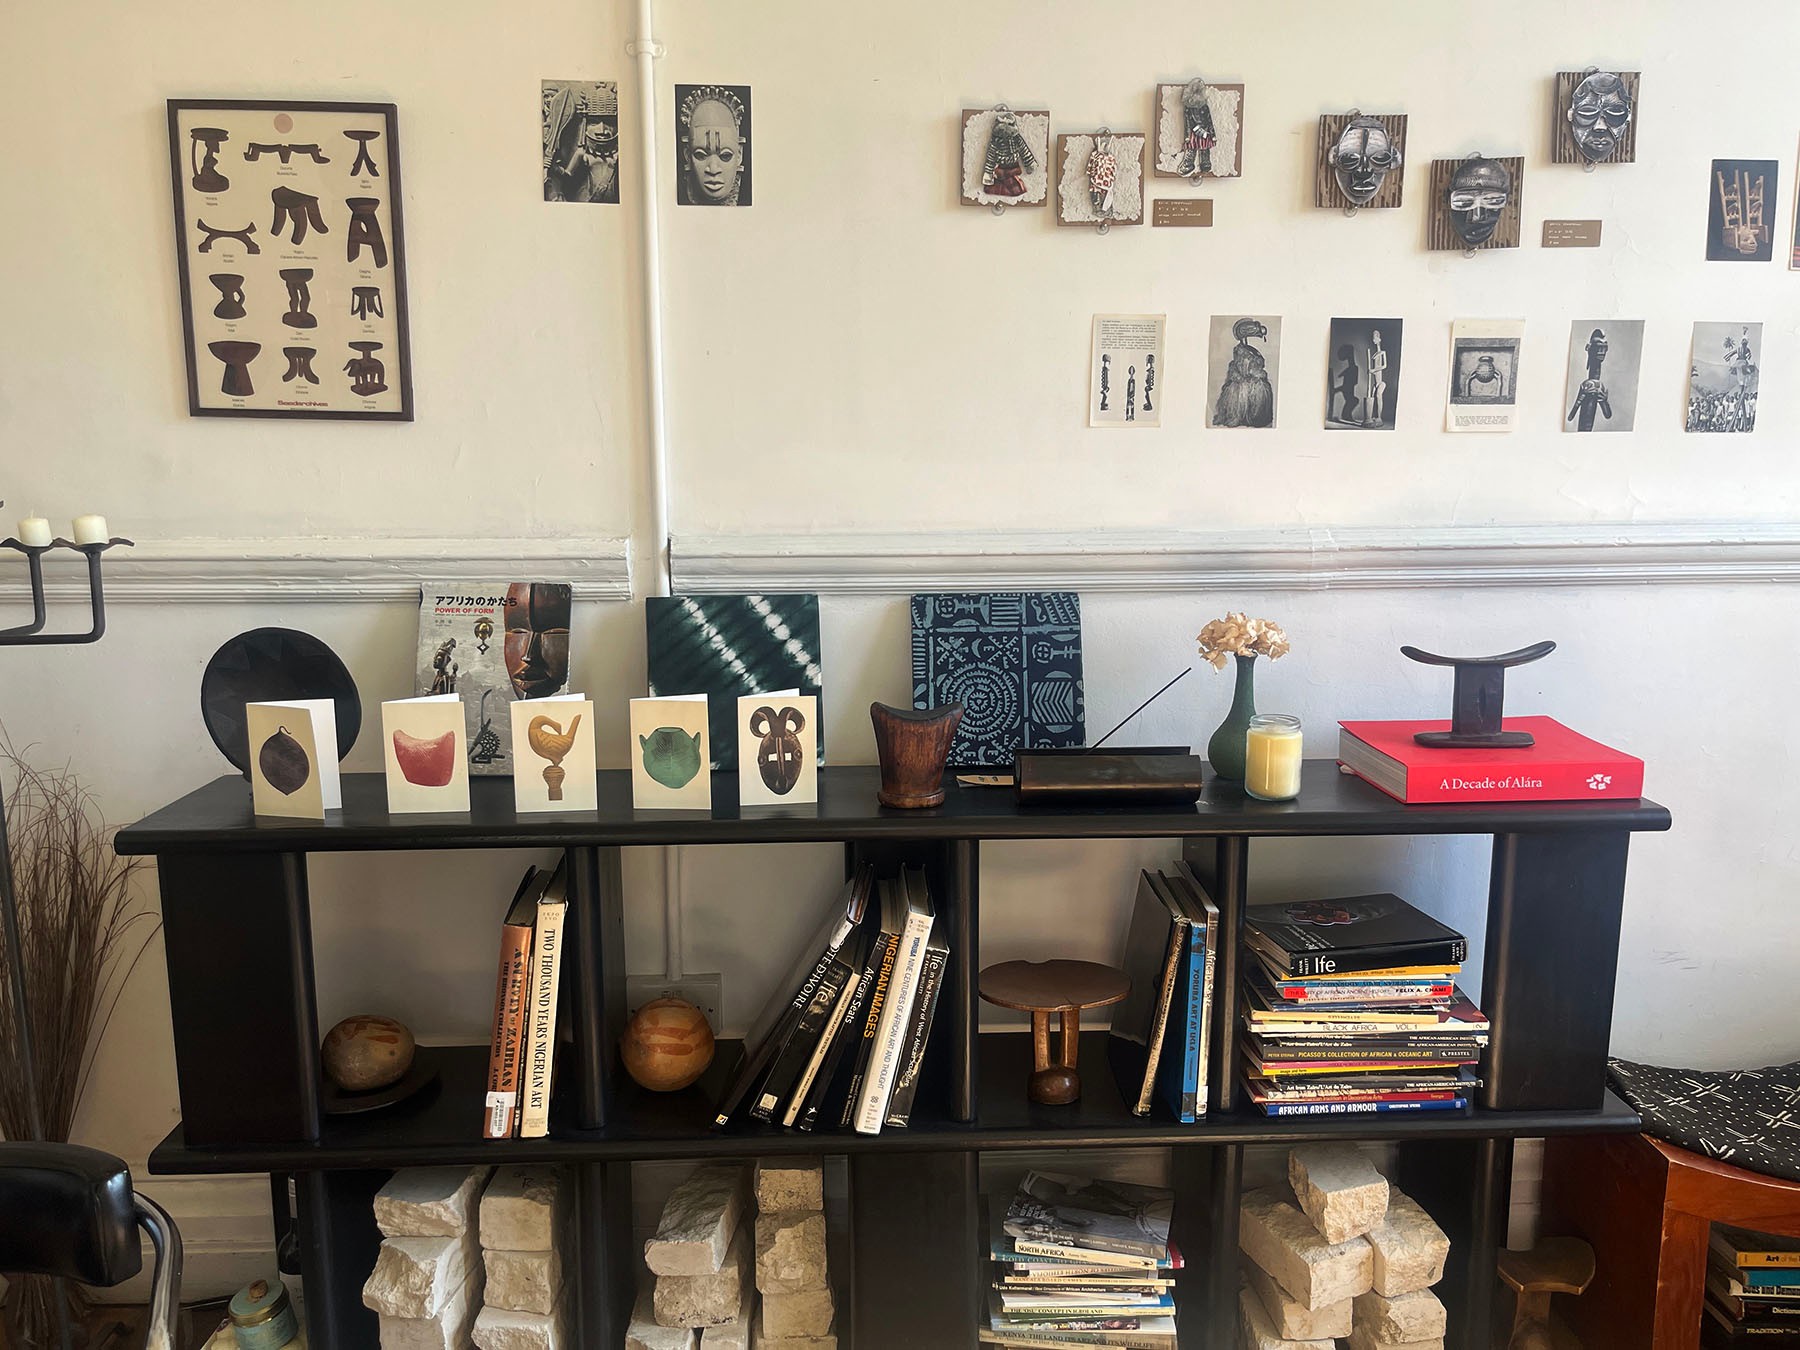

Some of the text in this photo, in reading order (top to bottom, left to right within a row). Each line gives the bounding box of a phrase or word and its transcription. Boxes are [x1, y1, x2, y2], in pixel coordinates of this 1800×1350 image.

[435, 595, 518, 607] アフリカのかたち
[1440, 777, 1542, 790] A Decade of Alára
[542, 928, 555, 951] TWO
[929, 954, 943, 970] Ife
[1204, 948, 1216, 980] African
[1315, 956, 1336, 973] Ife
[536, 953, 554, 1006] THOUSAND
[926, 978, 936, 990] the
[929, 971, 937, 979] in
[1191, 968, 1199, 1000] YORUBA
[508, 961, 523, 1016] SURVEY
[792, 963, 826, 1009] D'IVOIRE
[816, 981, 838, 1001] Ife
[844, 966, 875, 1025] African Seats
[864, 934, 902, 1039] NIGERIAN IMAGES
[919, 990, 932, 1012] History
[877, 936, 919, 1089] YORUBA NINE CENTURIES OF AFRICAN ART AND THOUGHT
[919, 1012, 927, 1020] of
[535, 1008, 549, 1039] YEARS
[915, 1020, 925, 1037] West
[1190, 1020, 1196, 1030] AT
[494, 1012, 504, 1057] COLLECTION
[501, 1027, 517, 1087] ZAIRIAN
[909, 1037, 920, 1058] African
[531, 1040, 547, 1088] NIGERIAN
[530, 1090, 543, 1108] ART
[1278, 1102, 1377, 1115] AFRICAN ARMS AND ARMOUR
[1017, 1245, 1065, 1256] NORTH AFRICA
